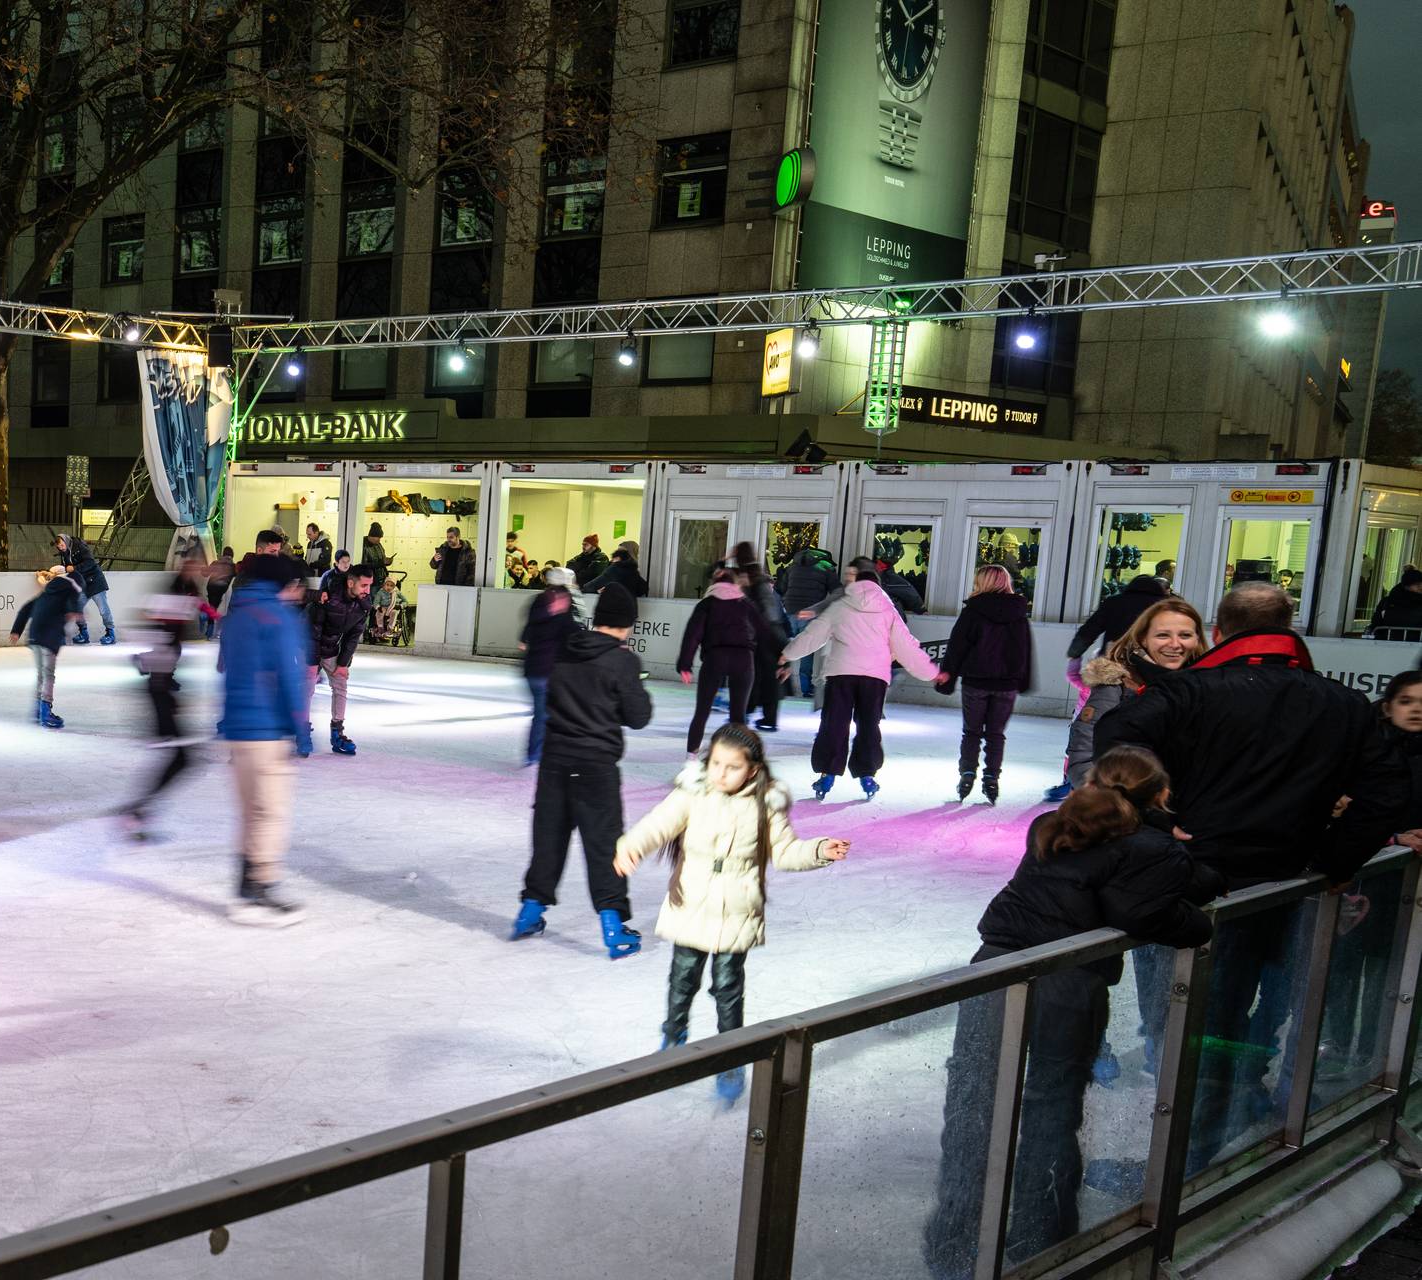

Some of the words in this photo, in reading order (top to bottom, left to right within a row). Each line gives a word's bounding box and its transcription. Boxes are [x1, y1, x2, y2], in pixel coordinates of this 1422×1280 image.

[866, 235, 911, 260] LEPPING
[931, 397, 998, 423] LEPPING
[1011, 410, 1032, 423] TUDOR
[242, 412, 405, 441] IONAL-BANK
